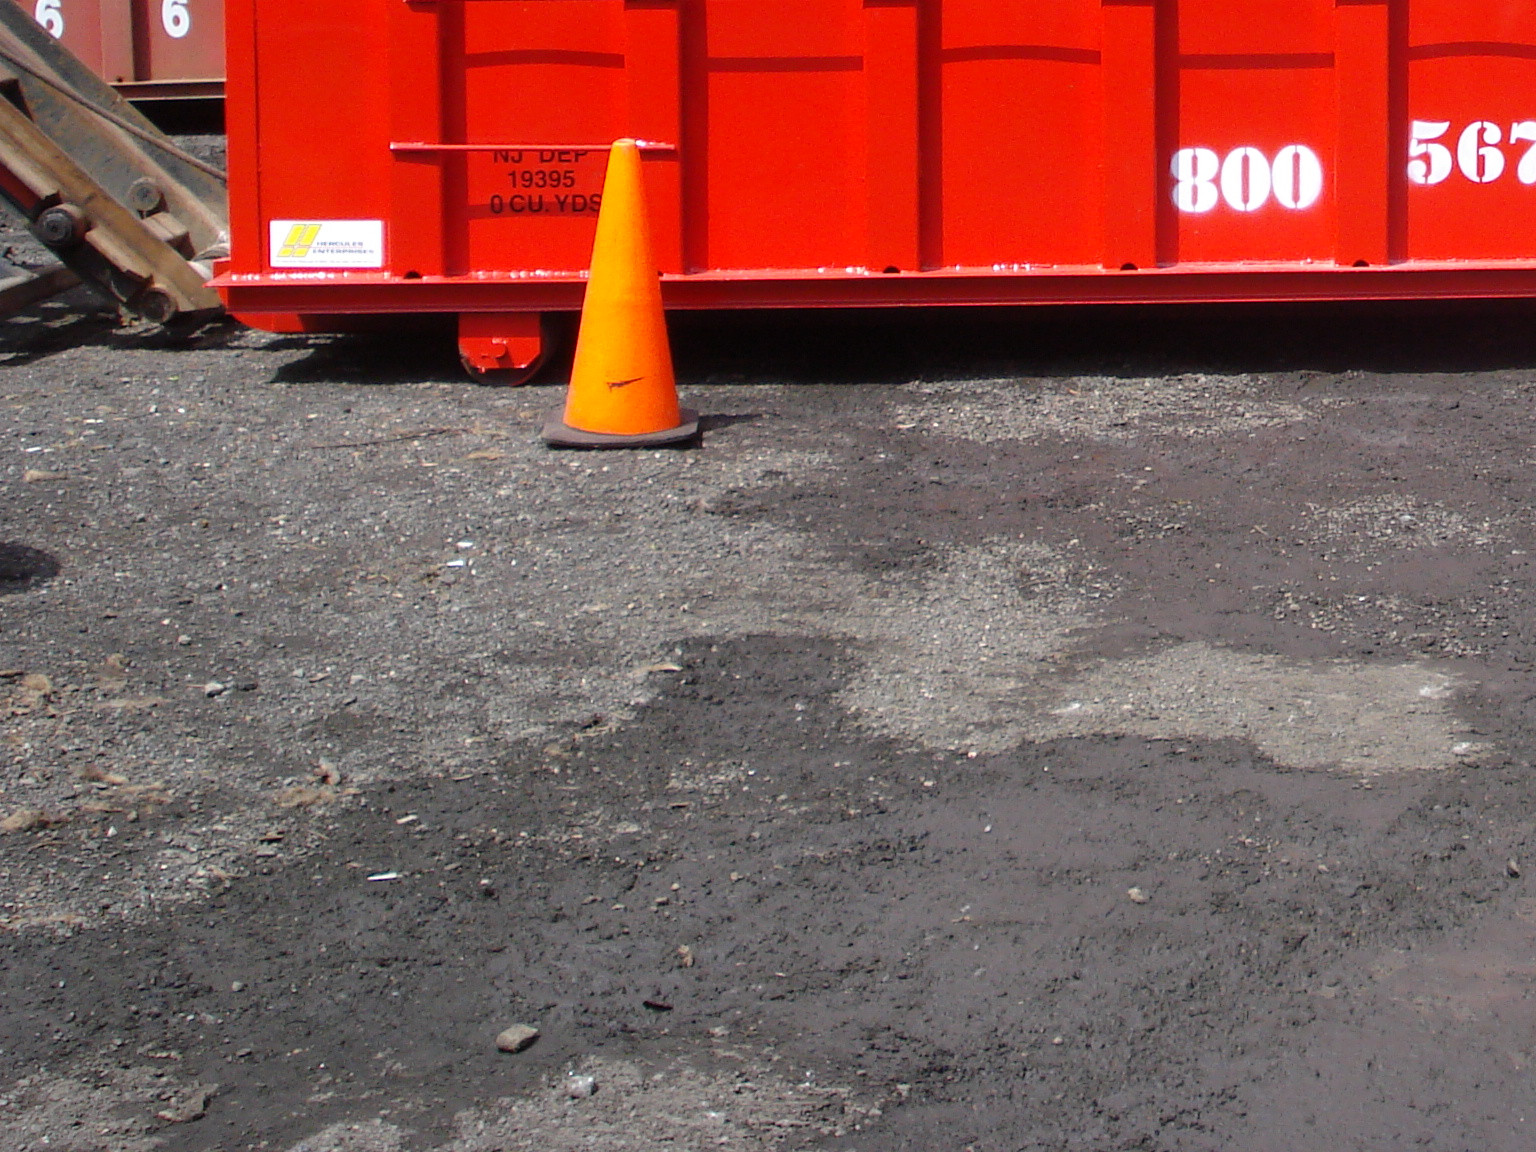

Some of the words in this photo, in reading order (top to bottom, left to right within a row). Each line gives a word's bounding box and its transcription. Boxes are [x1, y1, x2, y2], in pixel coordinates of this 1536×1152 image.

[493, 149, 523, 164] NJ
[539, 150, 588, 163] DEP
[508, 170, 575, 189] 19395
[1171, 145, 1325, 215] 800
[509, 194, 549, 213] CU.
[554, 193, 602, 213] YDS
